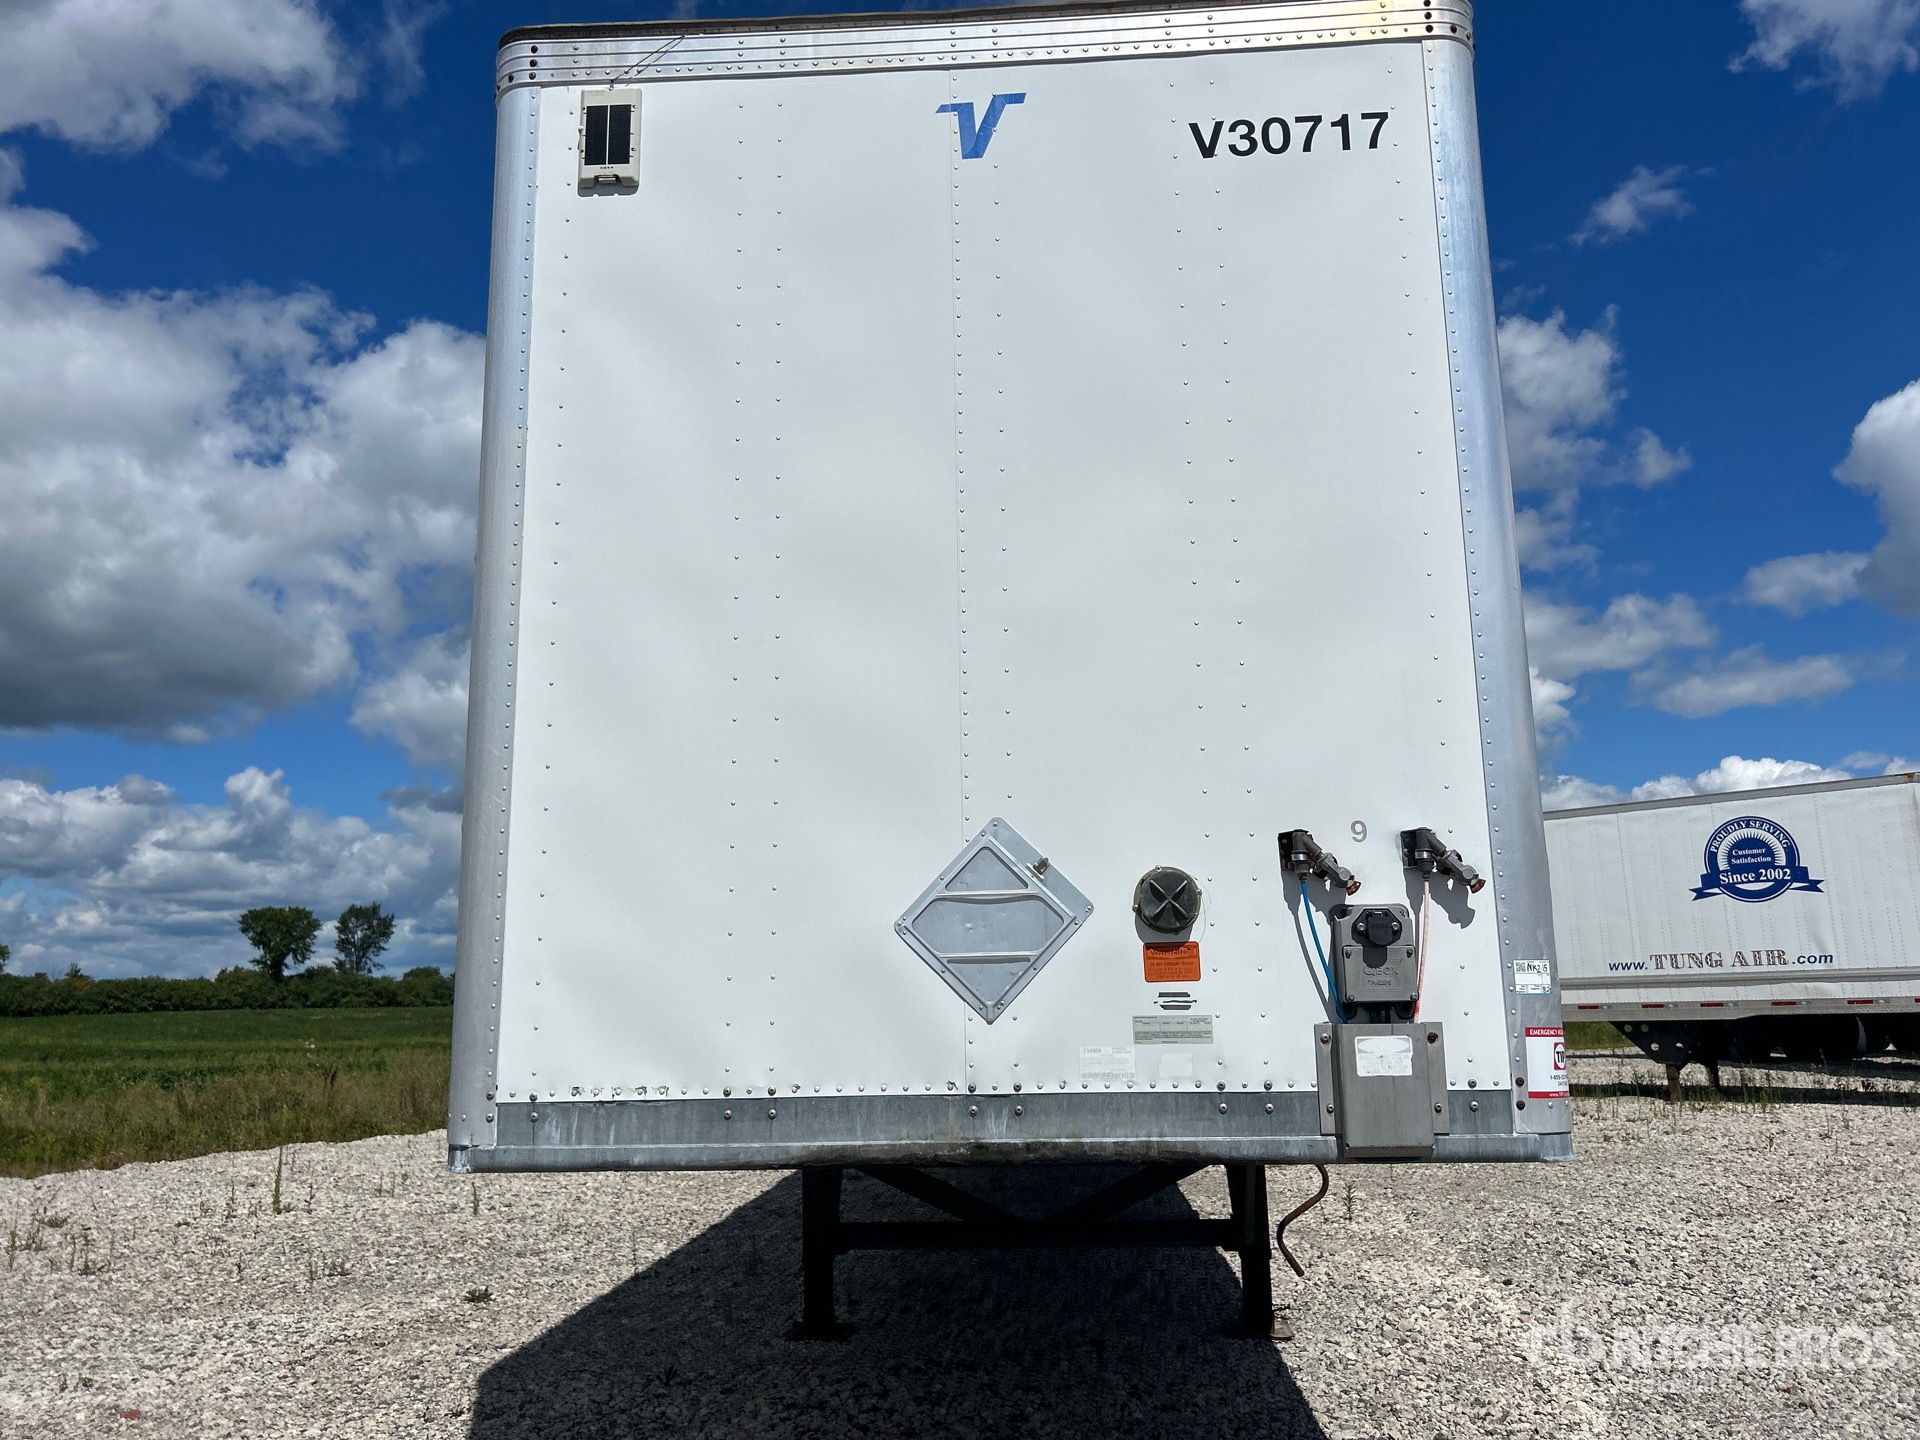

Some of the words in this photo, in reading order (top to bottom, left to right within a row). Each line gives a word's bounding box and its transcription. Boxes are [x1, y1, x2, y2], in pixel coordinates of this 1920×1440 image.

[1188, 111, 1389, 159] V30717
[1350, 820, 1367, 843] 9
[1710, 820, 1747, 853] PROUDLY
[1749, 820, 1791, 848] SERVING
[1731, 856, 1772, 865] Satisfaction
[1732, 848, 1766, 856] Customer
[1719, 872, 1756, 885] Since
[1758, 868, 1791, 880] 2002
[1650, 952, 1724, 970] TUNG
[1730, 949, 1789, 967] AIR
